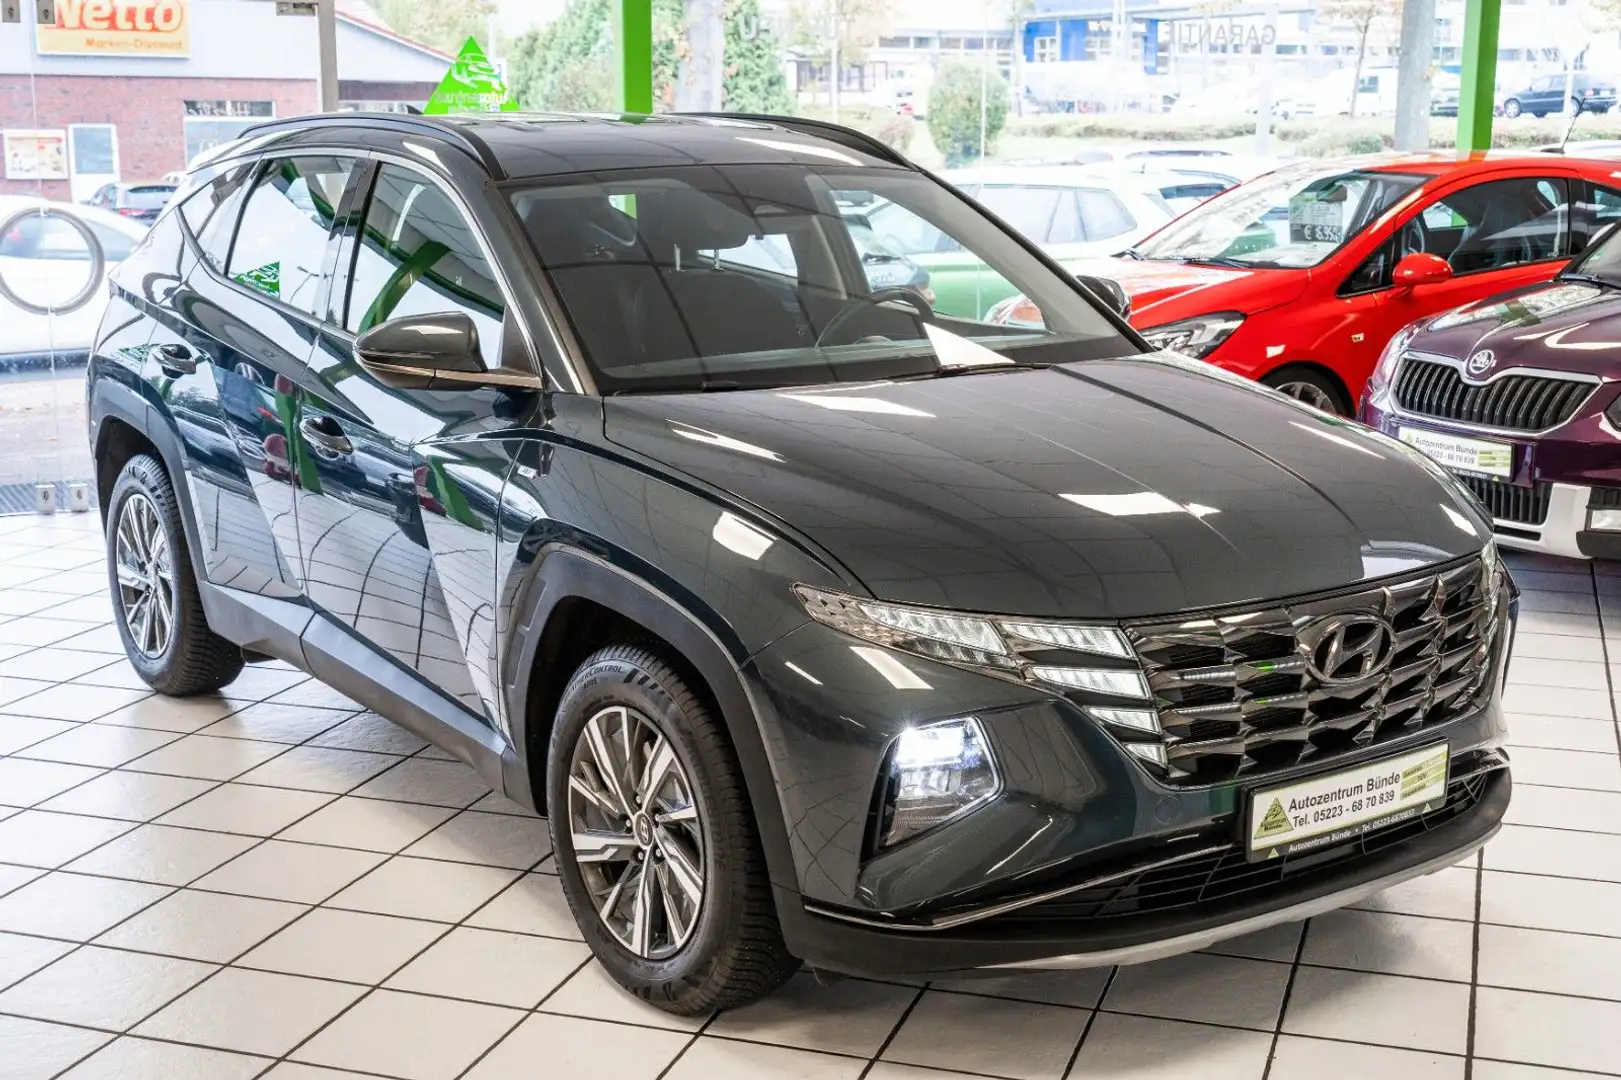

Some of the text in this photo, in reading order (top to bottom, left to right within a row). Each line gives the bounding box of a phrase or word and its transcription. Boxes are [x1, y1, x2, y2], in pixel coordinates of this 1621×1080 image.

[56, 0, 183, 32] Netto
[1415, 437, 1455, 452] Autozentrum
[1288, 772, 1400, 812] Autozentrum Bünde
[1292, 814, 1310, 828] Tel.
[1313, 805, 1343, 823] 05223
[1352, 800, 1363, 812] 68
[1366, 795, 1377, 809] 70
[1378, 790, 1395, 805] 839
[1288, 829, 1352, 853] Autozentrum Bünde
